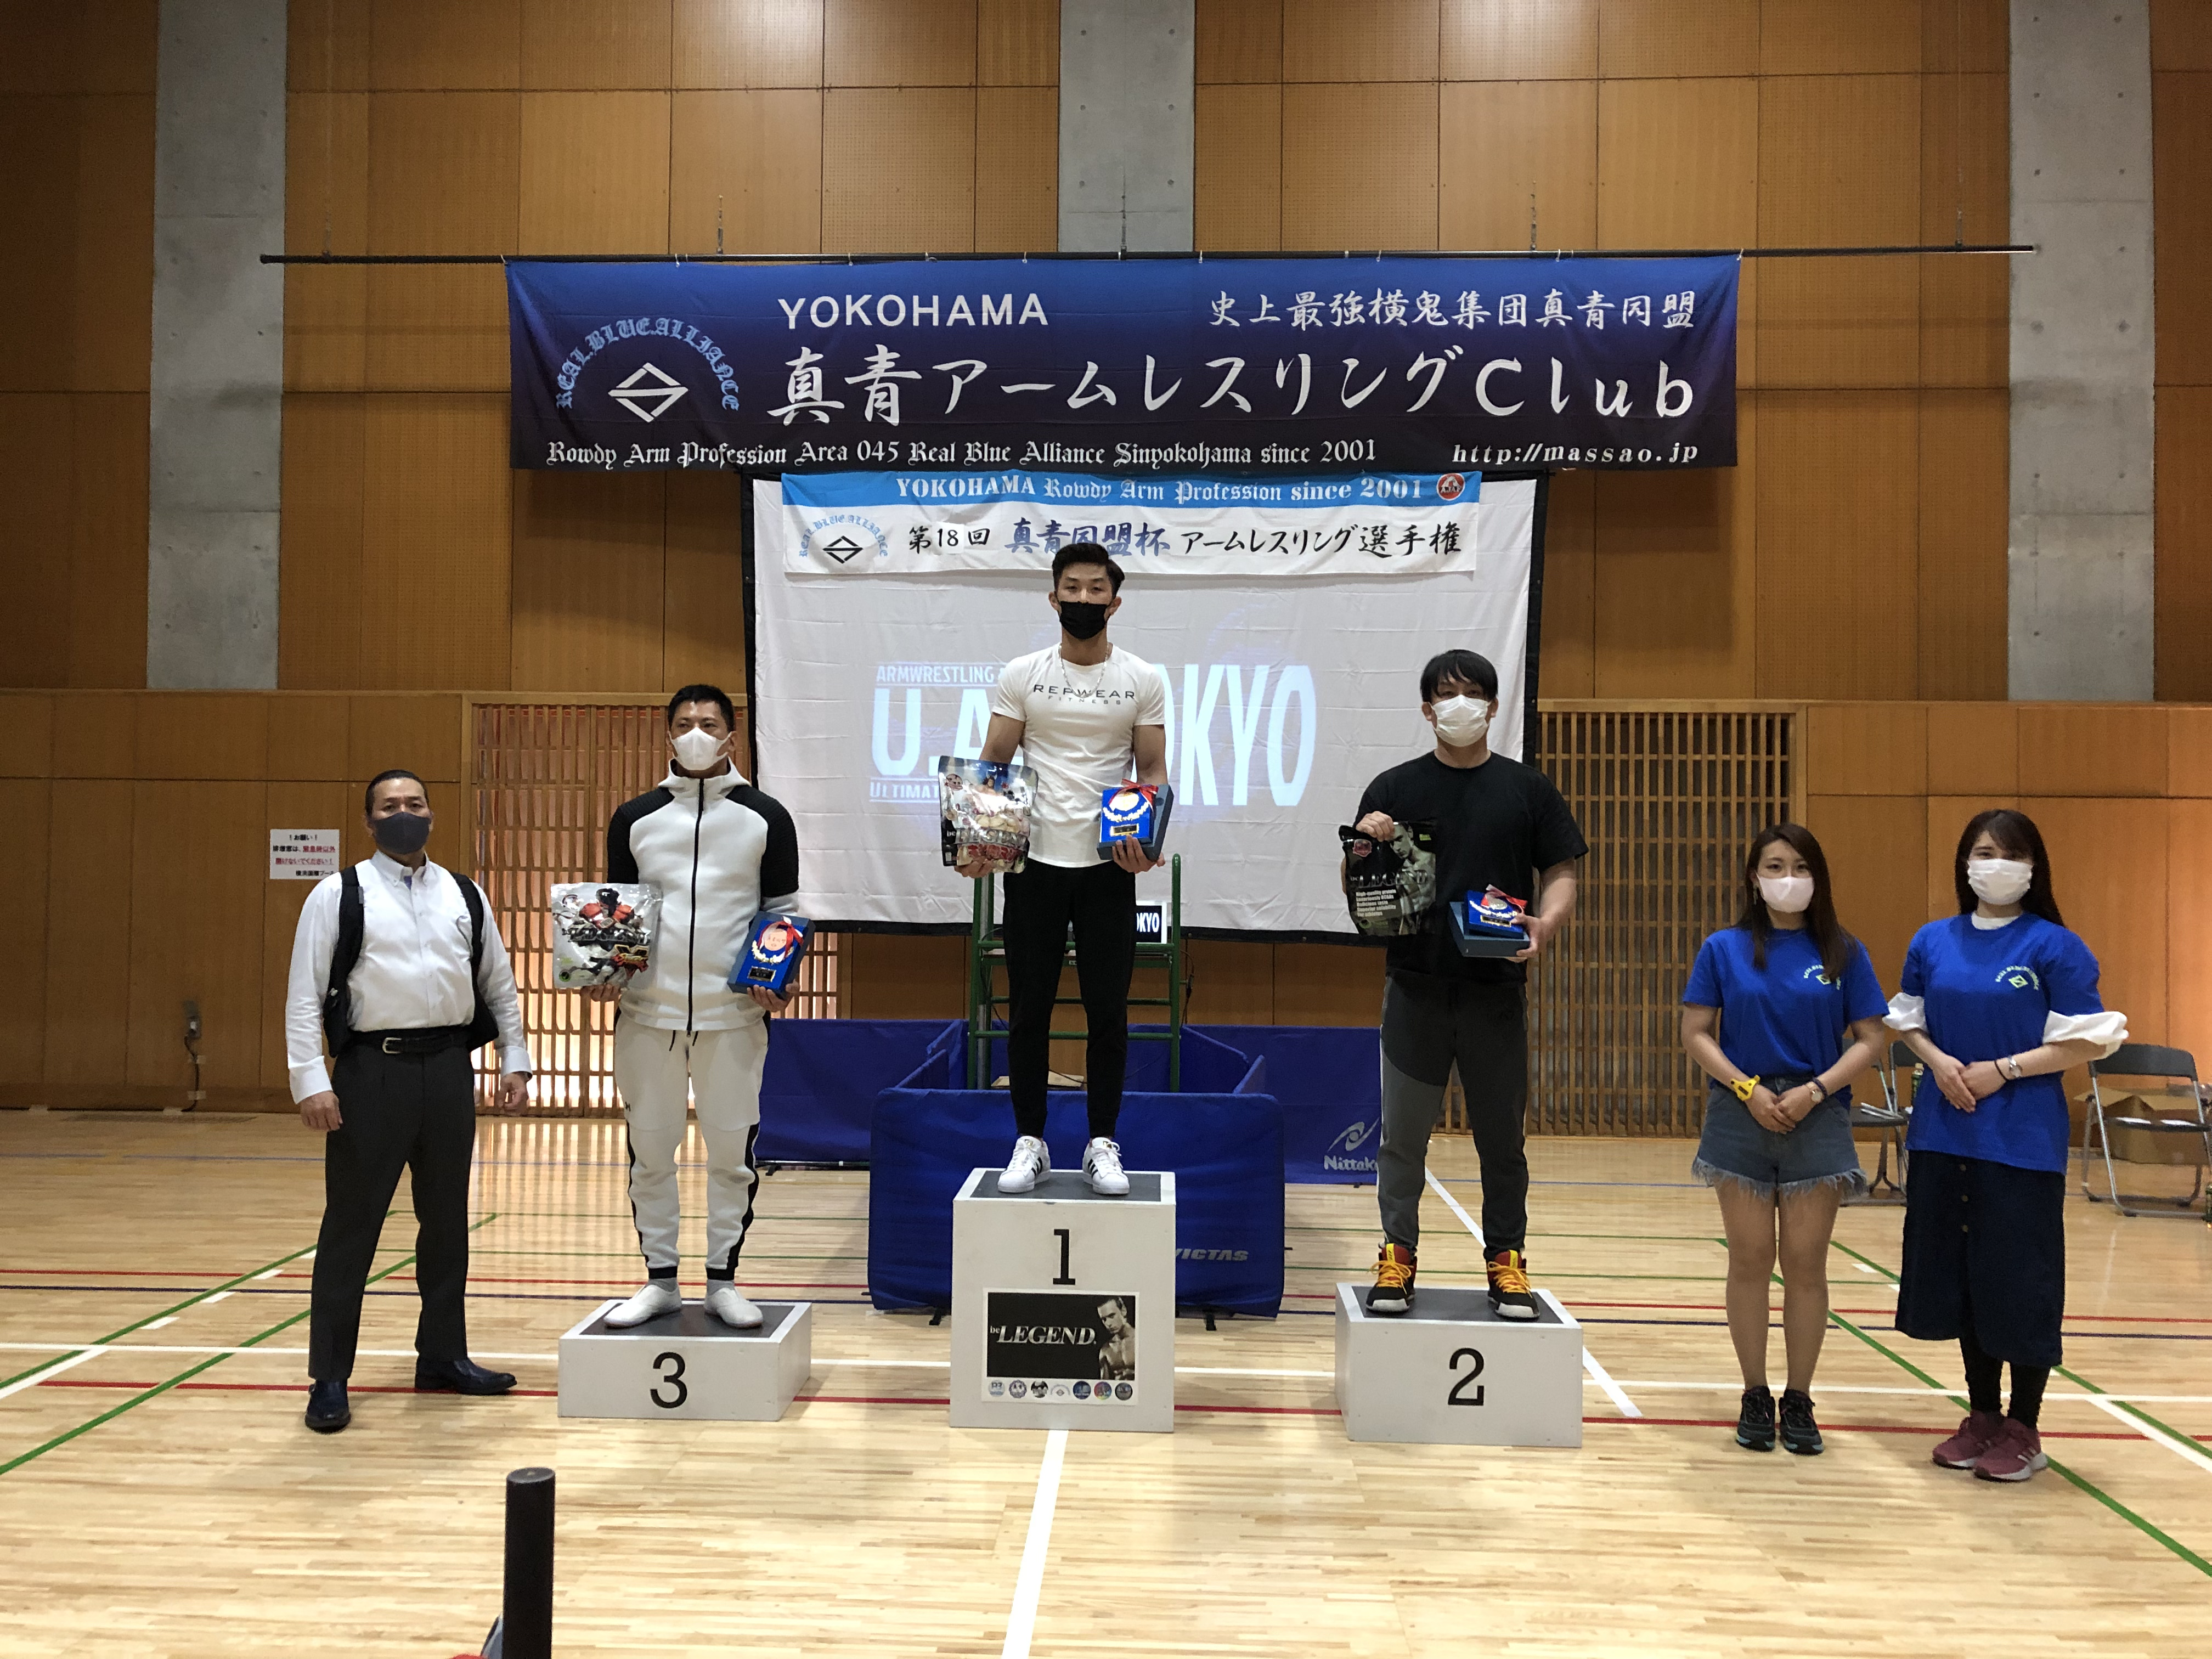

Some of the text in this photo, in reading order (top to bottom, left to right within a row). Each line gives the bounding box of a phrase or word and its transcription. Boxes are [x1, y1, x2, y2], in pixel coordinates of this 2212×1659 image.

[778, 293, 1048, 329] YOKOHAMA
[546, 439, 1376, 470] Rowdy Arm Profession Area 045 Real Blue Alliance Sinyokohama since 2001
[1452, 442, 1699, 466] http://massao.jp
[896, 475, 1421, 505] YOKOHAMA Rowdy Arm Profession since 2001
[909, 525, 990, 554] 第18回
[1180, 521, 1462, 558] アームレスリング選手権
[876, 665, 995, 683] ARMWRESTLING
[1033, 684, 1135, 699] REPWEAR
[1048, 695, 1121, 705] FITNESS
[1052, 1228, 1076, 1285] 1
[650, 1352, 687, 1409] 3
[1447, 1347, 1485, 1406] 2
